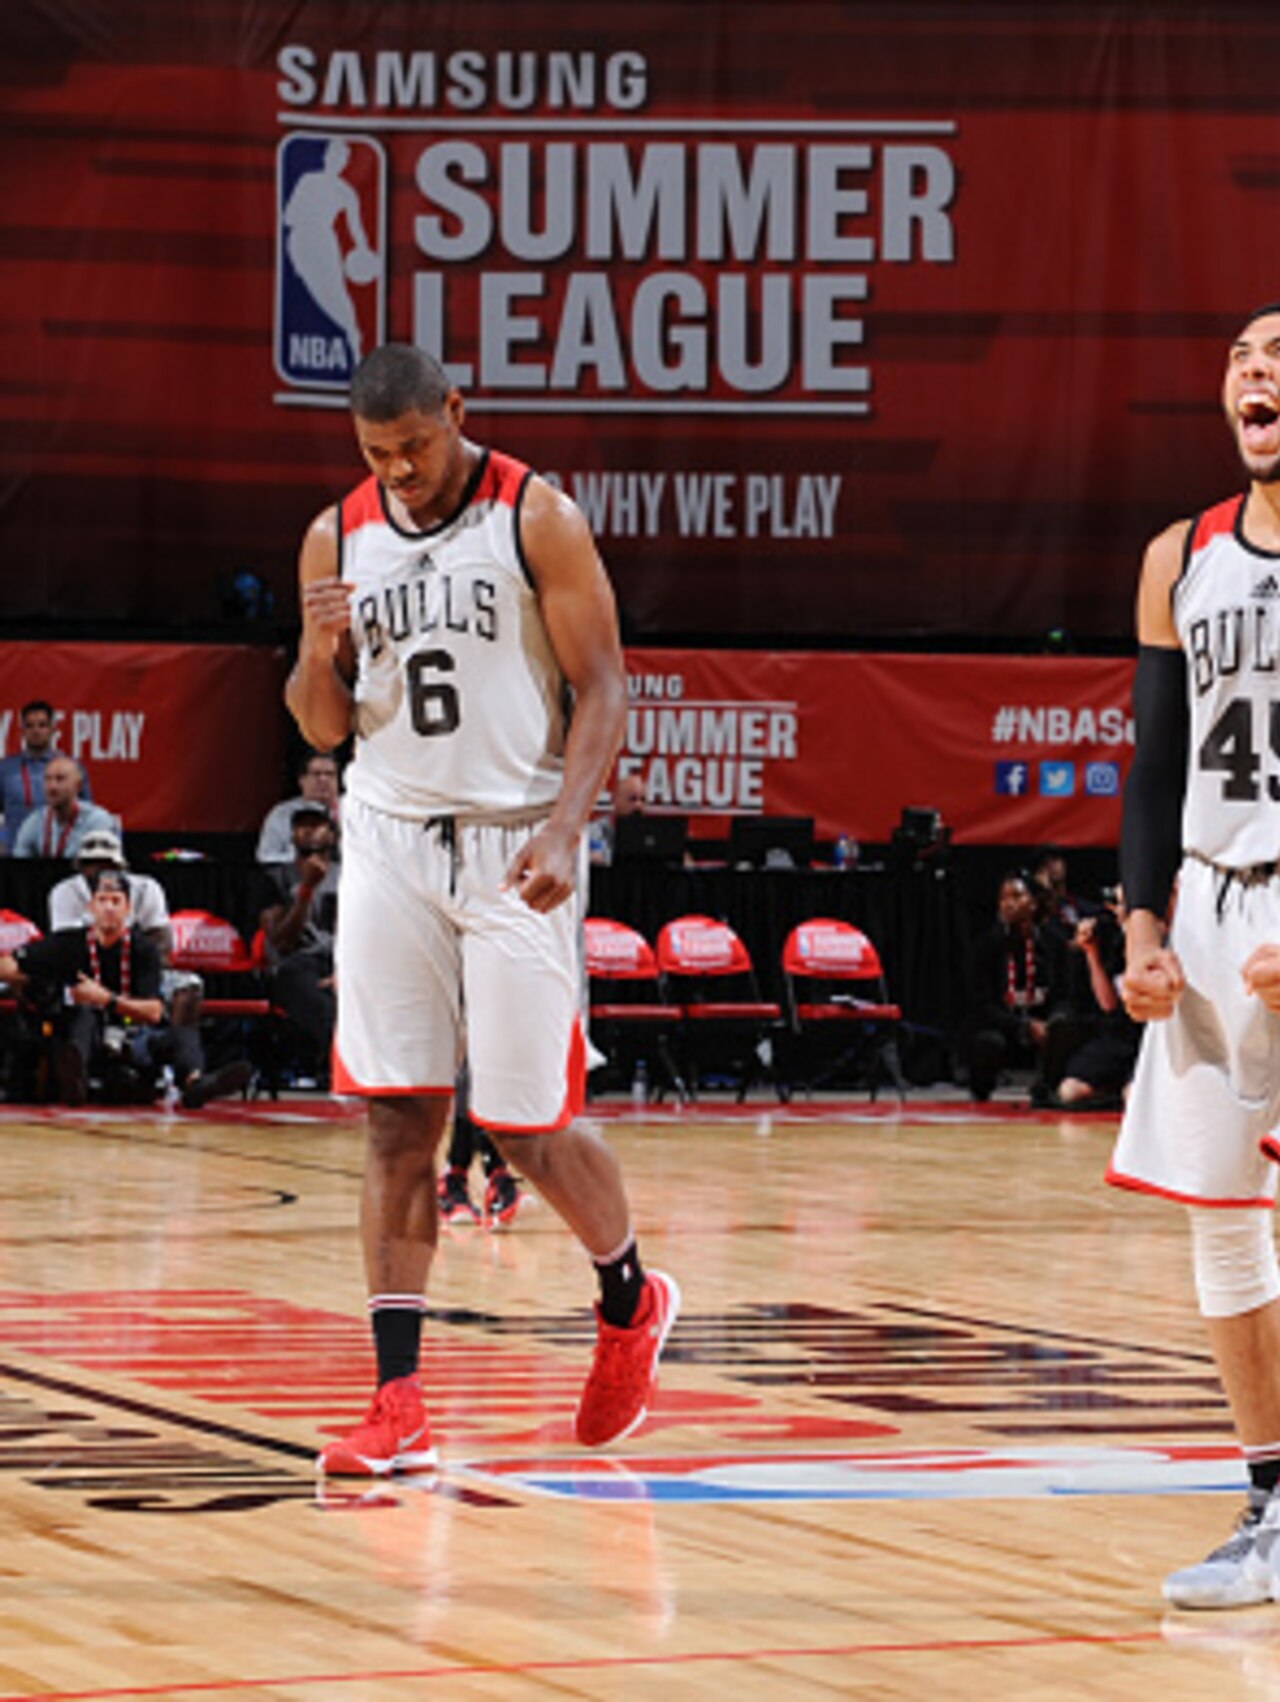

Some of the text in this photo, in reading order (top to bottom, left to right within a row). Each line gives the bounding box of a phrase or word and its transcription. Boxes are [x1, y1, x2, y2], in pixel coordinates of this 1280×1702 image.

[276, 45, 648, 111] SAMSUNG
[412, 140, 956, 262] SUMMER
[289, 333, 347, 370] NBA
[411, 271, 871, 392] LEAGUE
[572, 472, 842, 538] WHY WE PLAY
[359, 576, 496, 659] BULLS
[406, 648, 461, 737] 6
[73, 709, 144, 760] PLAY
[627, 709, 798, 758] UMMER
